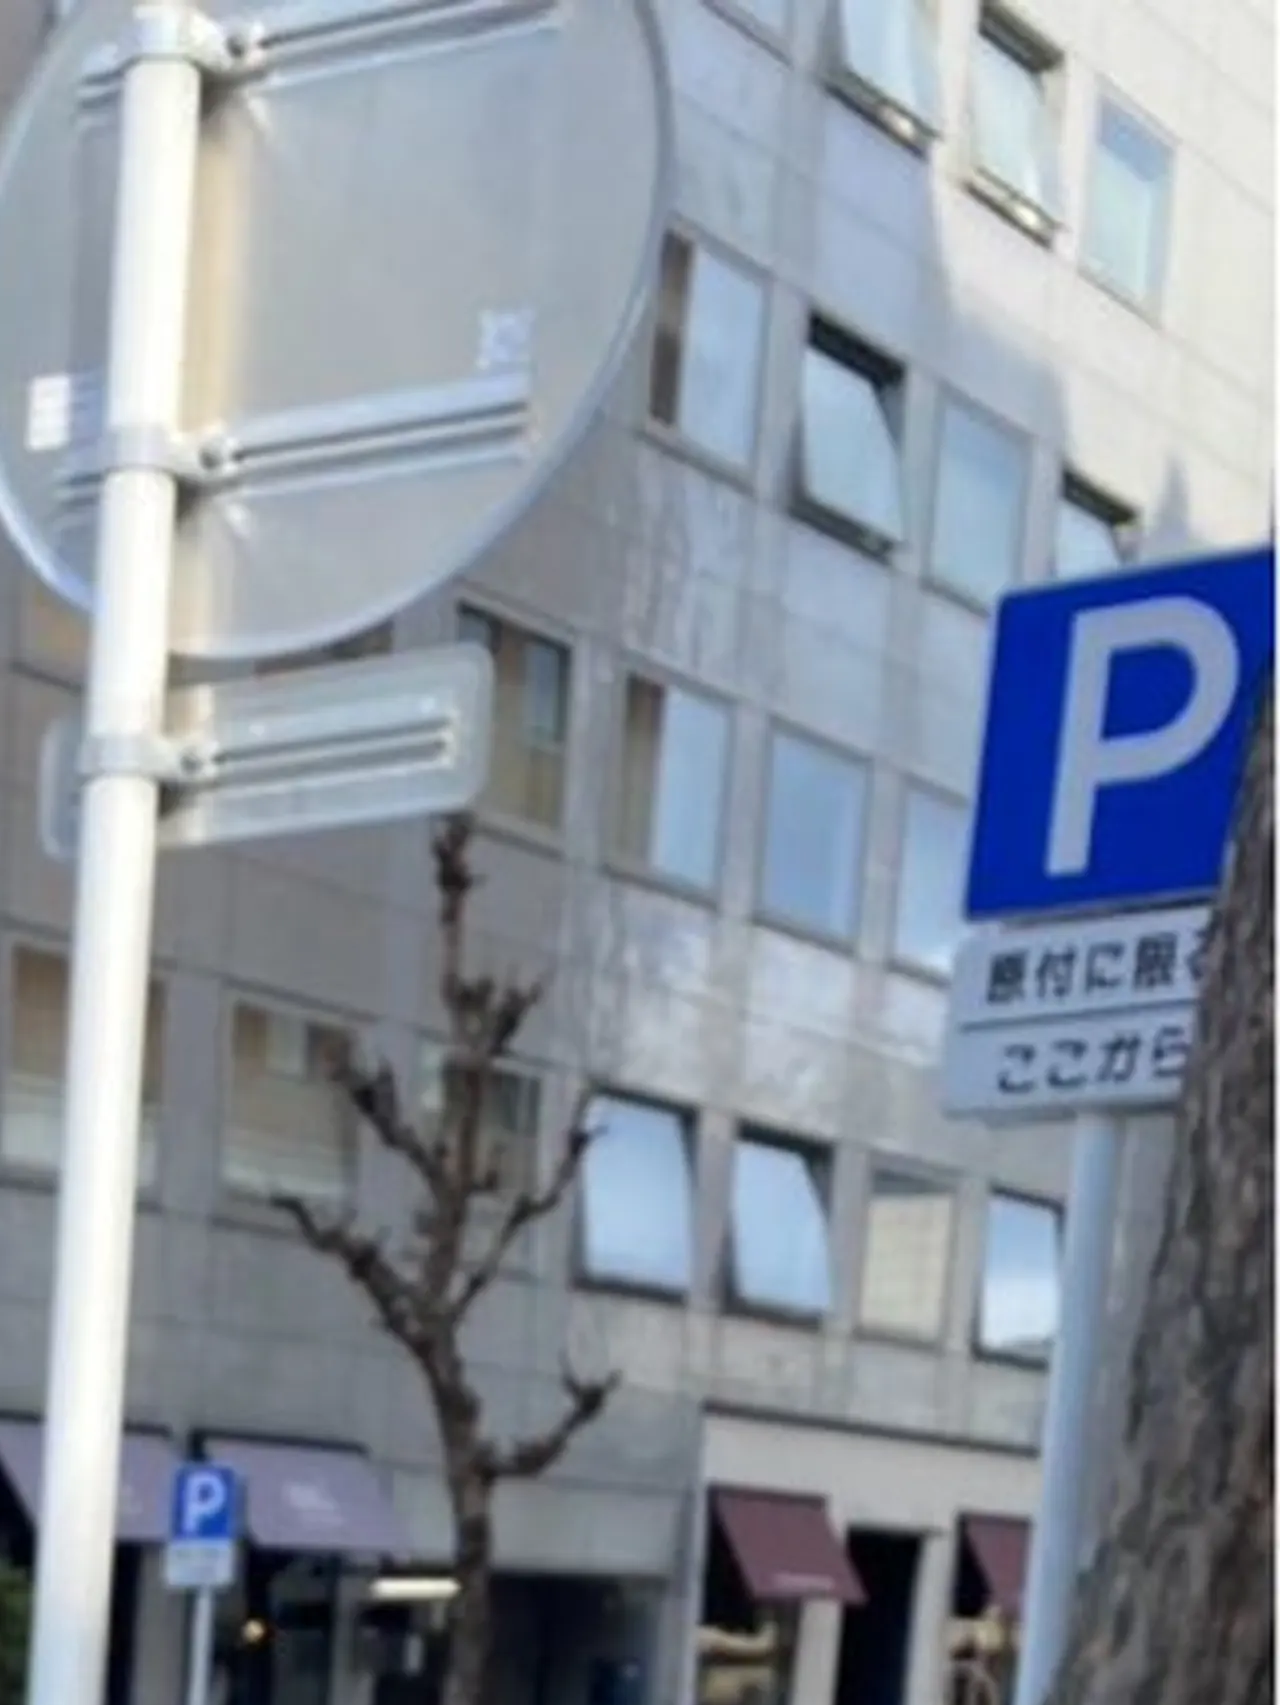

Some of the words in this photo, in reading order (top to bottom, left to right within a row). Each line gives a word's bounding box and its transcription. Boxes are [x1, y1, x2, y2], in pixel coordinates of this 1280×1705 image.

[1043, 596, 1240, 878] P
[996, 1026, 1191, 1094] ここから
[183, 1471, 227, 1534] P
